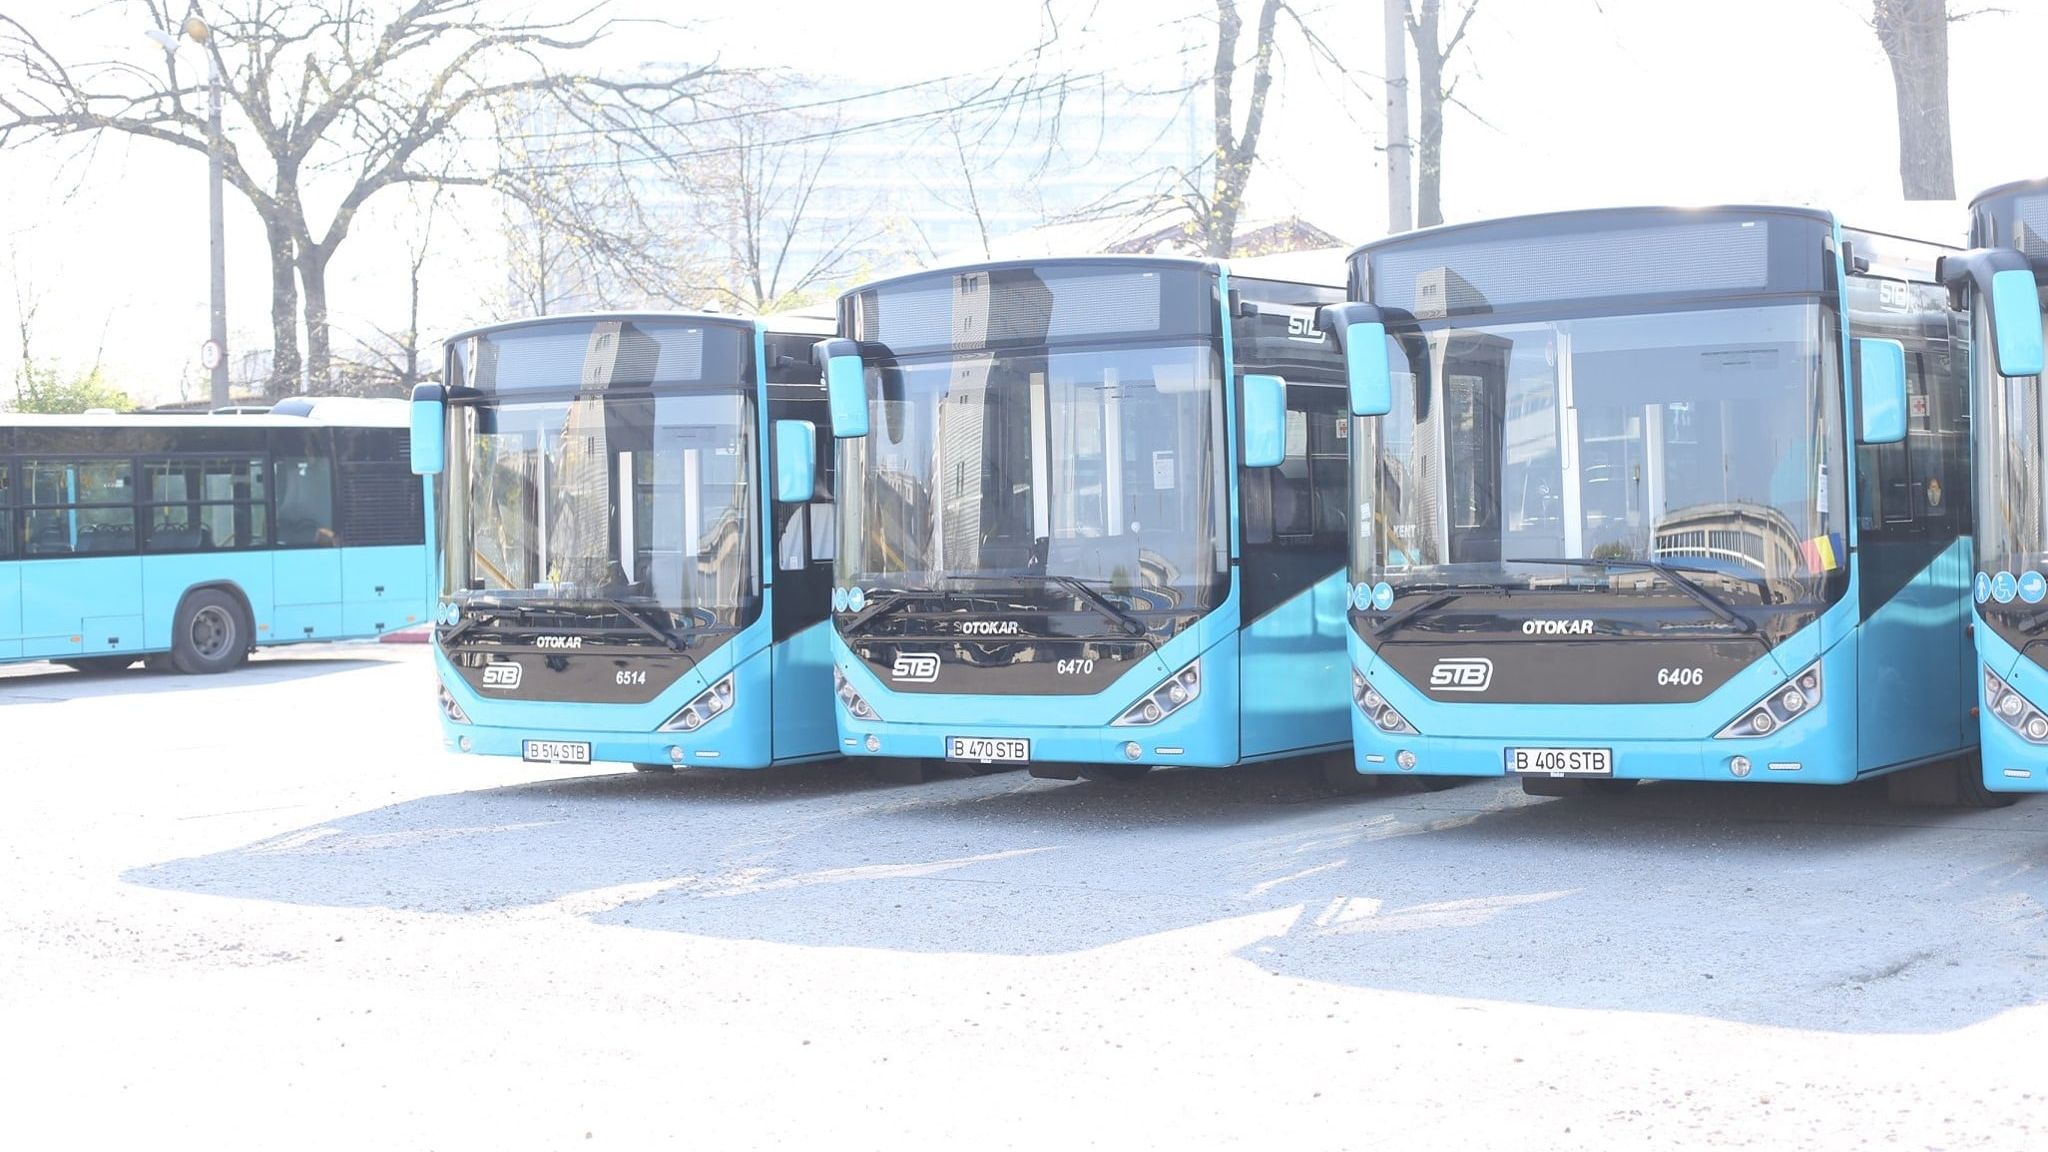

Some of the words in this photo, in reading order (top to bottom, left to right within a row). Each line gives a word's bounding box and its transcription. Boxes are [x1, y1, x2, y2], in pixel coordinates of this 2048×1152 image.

[1879, 281, 1906, 306] STB
[962, 620, 1018, 635] OTOKAR
[1522, 619, 1594, 635] OTOKAR
[536, 635, 582, 649] OTOKAR
[482, 665, 519, 684] STB
[891, 657, 937, 678] STB
[1056, 658, 1093, 675] 6470
[1430, 663, 1488, 686] STB
[615, 671, 646, 685] 6514
[1657, 668, 1703, 686] 6406
[530, 743, 539, 757] B
[542, 744, 559, 758] 514
[561, 744, 585, 759] STB
[954, 740, 964, 756] B
[969, 741, 993, 757] 470
[996, 742, 1025, 758] STB
[1516, 752, 1528, 769] B
[1535, 752, 1565, 769] 406
[1569, 752, 1605, 770] STB
